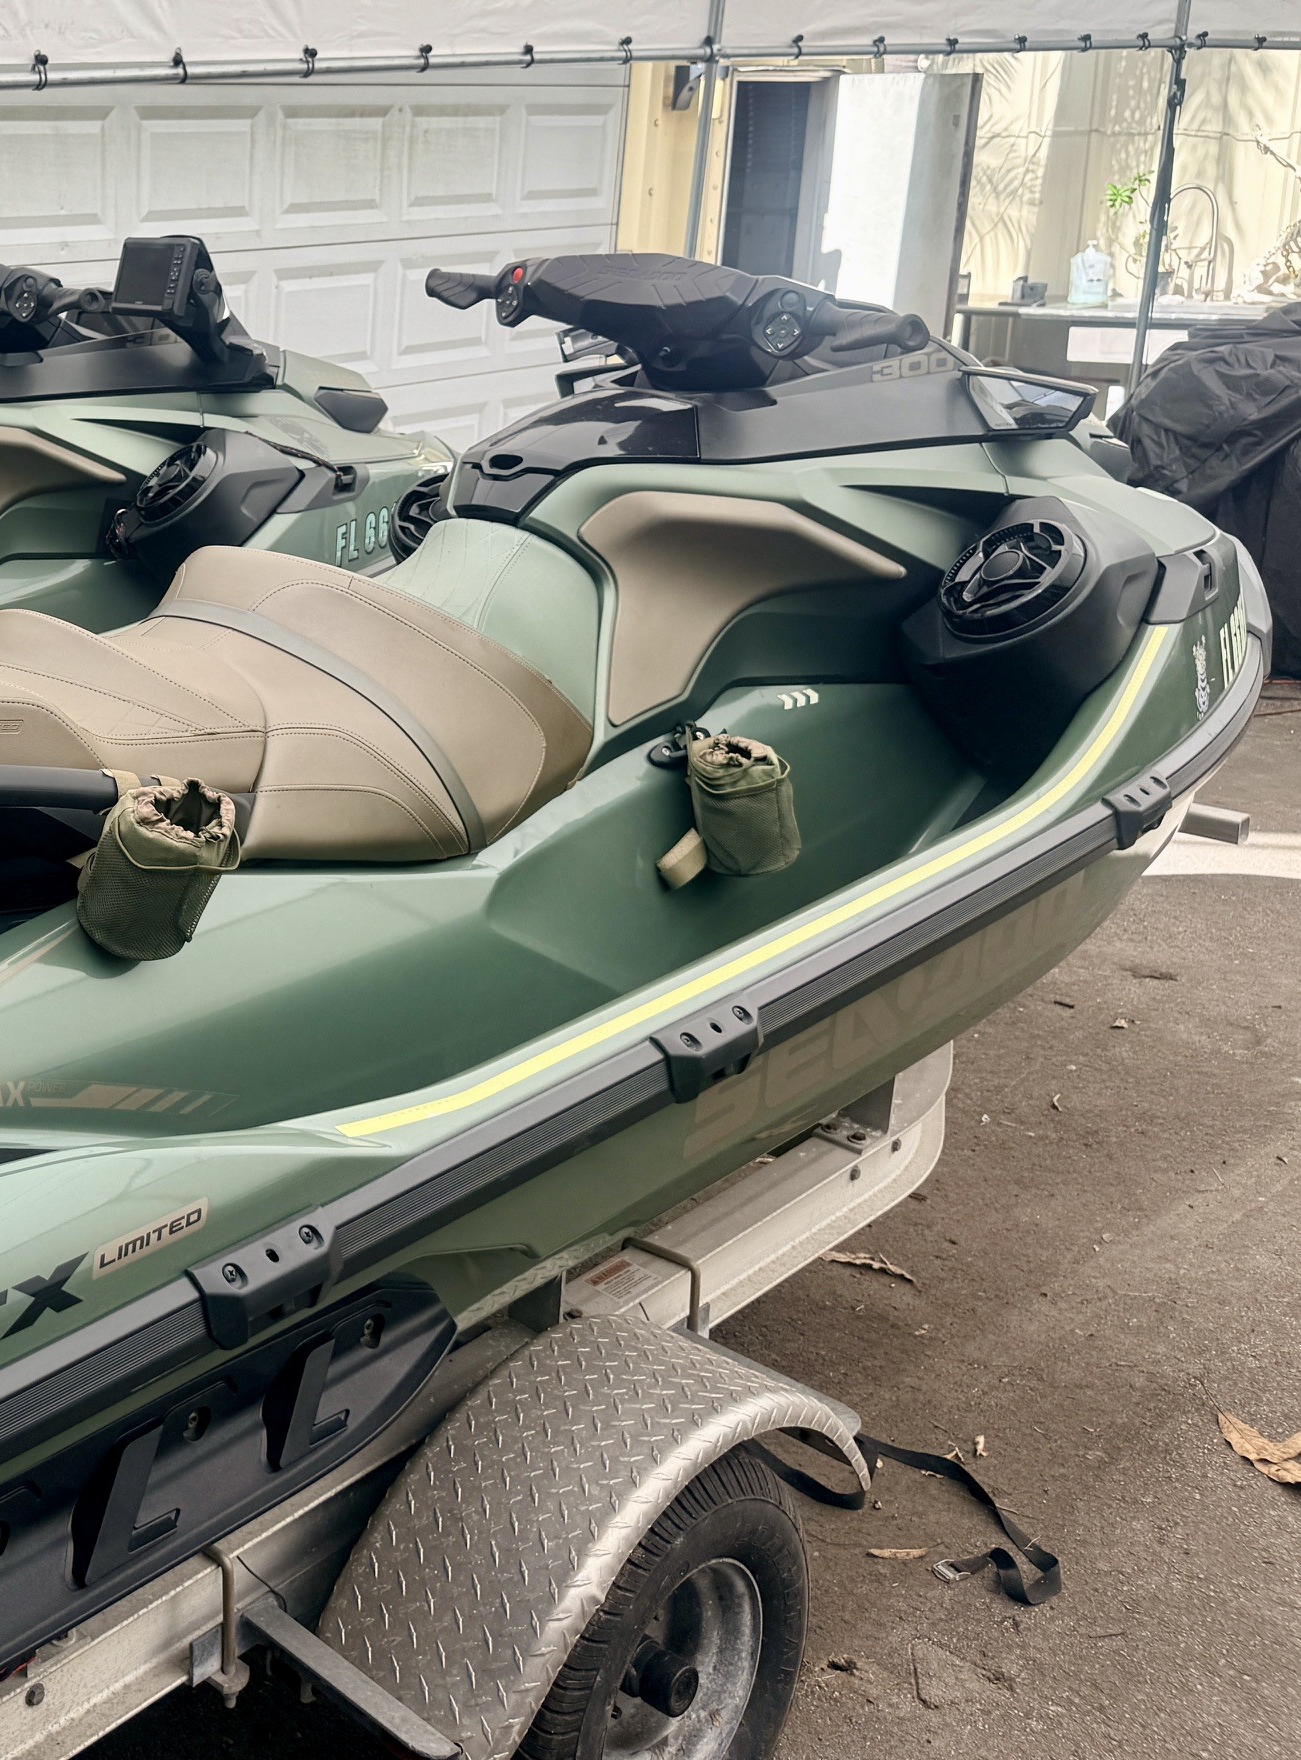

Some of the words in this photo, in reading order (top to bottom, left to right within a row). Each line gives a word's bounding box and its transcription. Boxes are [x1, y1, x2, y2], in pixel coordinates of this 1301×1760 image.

[872, 352, 954, 382] 300
[334, 518, 360, 568] FL
[364, 502, 398, 555] 66
[1220, 622, 1234, 690] FL
[99, 1207, 203, 1269] LIMITED
